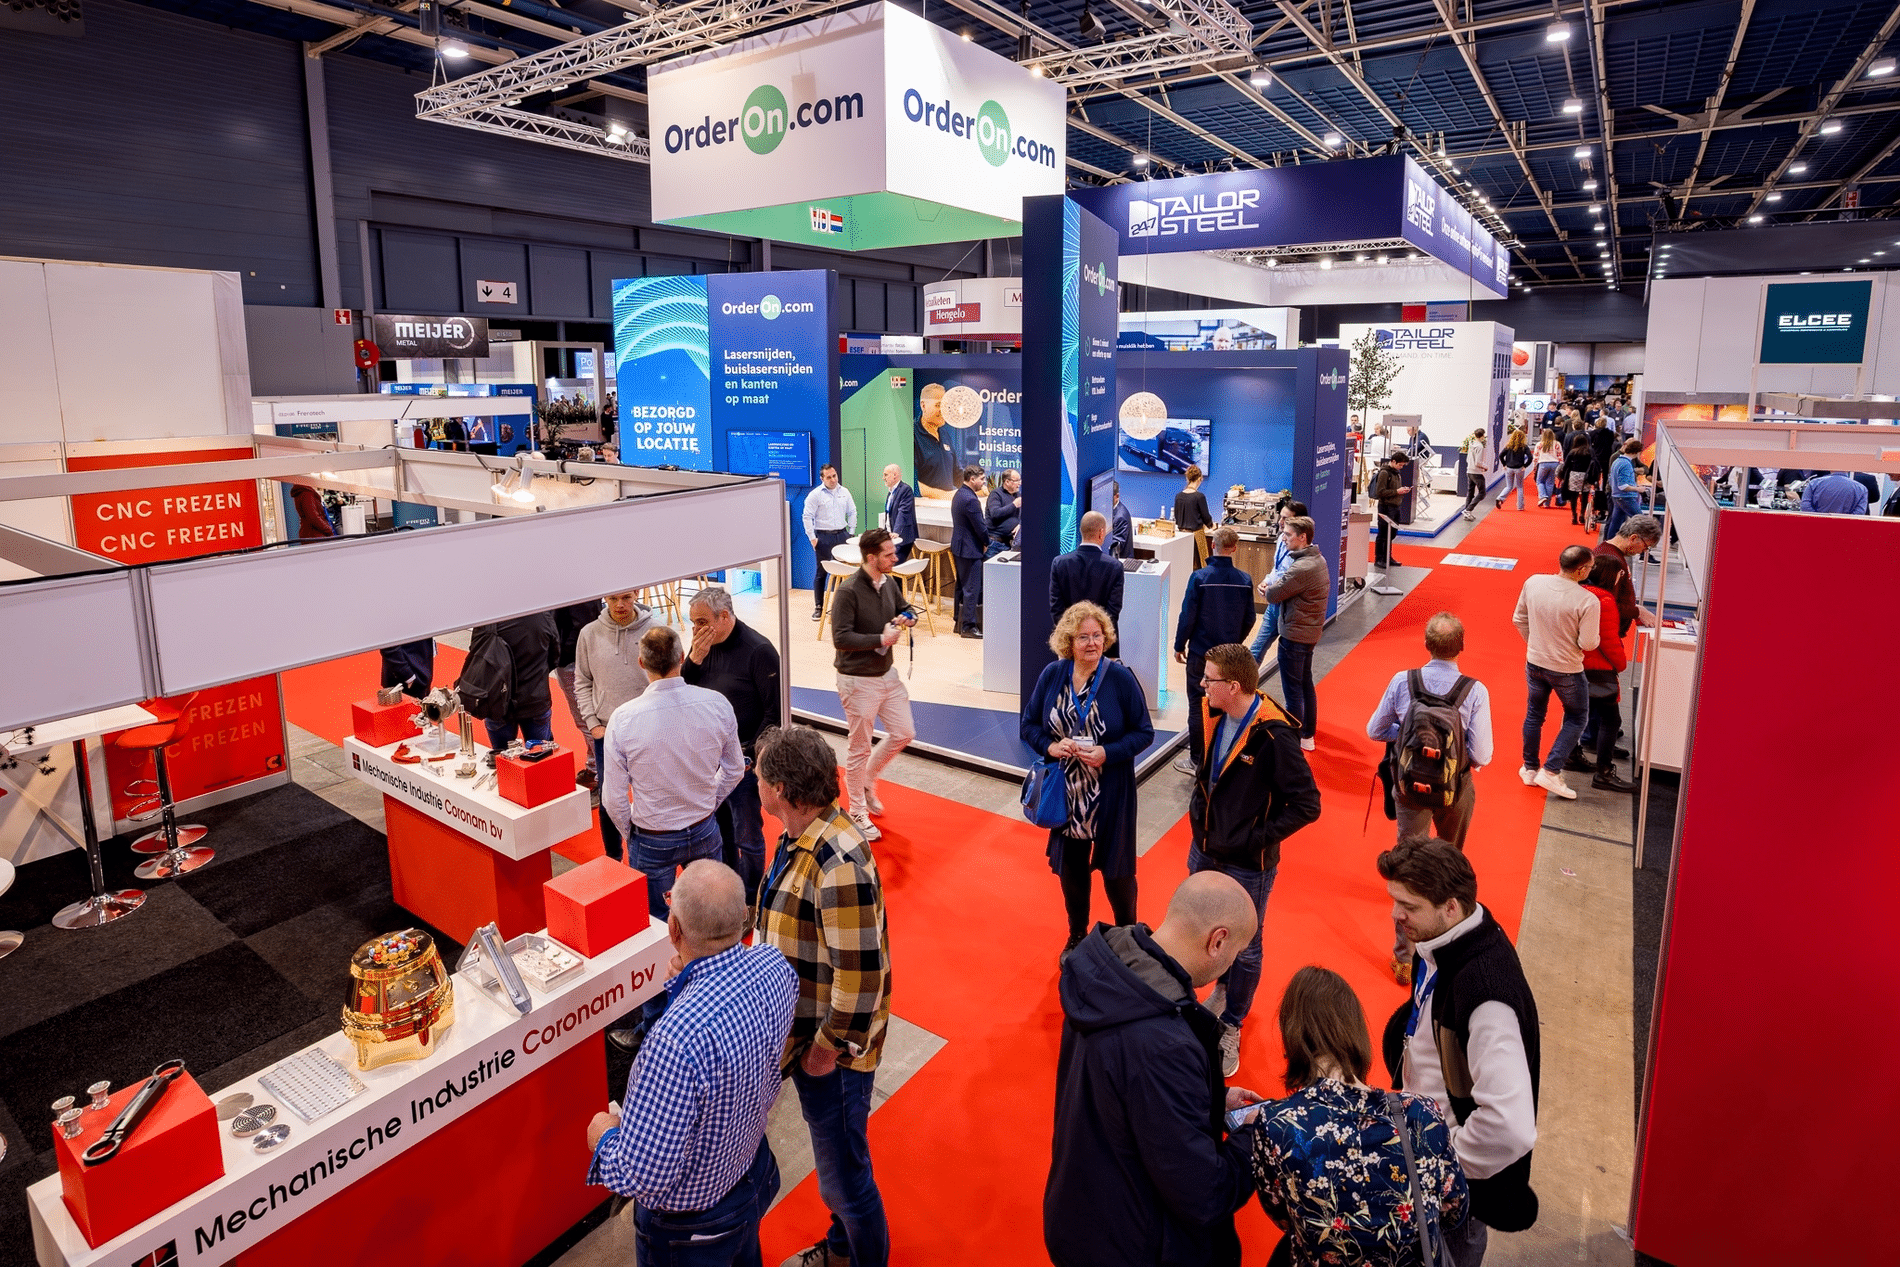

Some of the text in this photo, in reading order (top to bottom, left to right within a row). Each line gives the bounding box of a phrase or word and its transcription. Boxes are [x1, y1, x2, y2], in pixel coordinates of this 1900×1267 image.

[664, 92, 864, 154] OrderOn.com
[903, 88, 1056, 168] OrderOn.com
[1152, 189, 1260, 216] TAILOR
[1160, 210, 1260, 236] STEEL
[502, 286, 511, 298] 4
[1012, 292, 1023, 302] M
[722, 299, 814, 317] OrderOn.com
[936, 308, 966, 322] Hengelo
[1778, 314, 1852, 326] ELCEE
[394, 322, 465, 339] MEIJER
[1391, 328, 1454, 339] TAILOR
[396, 339, 417, 347] METAL
[1394, 339, 1454, 349] STEEL
[724, 349, 796, 361] Lasersnijden,
[724, 363, 813, 376] buislasersnijden
[725, 379, 778, 389] en kanten
[725, 394, 769, 406] op maat
[979, 388, 1023, 403] Order
[633, 406, 696, 419] BEZORGD
[634, 422, 696, 434] OP JOUW
[979, 425, 1022, 437] Lasersn
[636, 437, 699, 451] LOCATIE
[979, 440, 1022, 453] buislase
[979, 456, 1022, 468] en kant
[96, 492, 243, 522] CNC FREZEN
[100, 521, 245, 553] CNC FREZEN
[188, 692, 263, 724] FREZEN
[191, 720, 266, 752] FREZEN
[361, 758, 504, 840] Mechanische Industrie Coronam bv
[194, 960, 657, 1256] Mechanische Industrie Coronam bv
